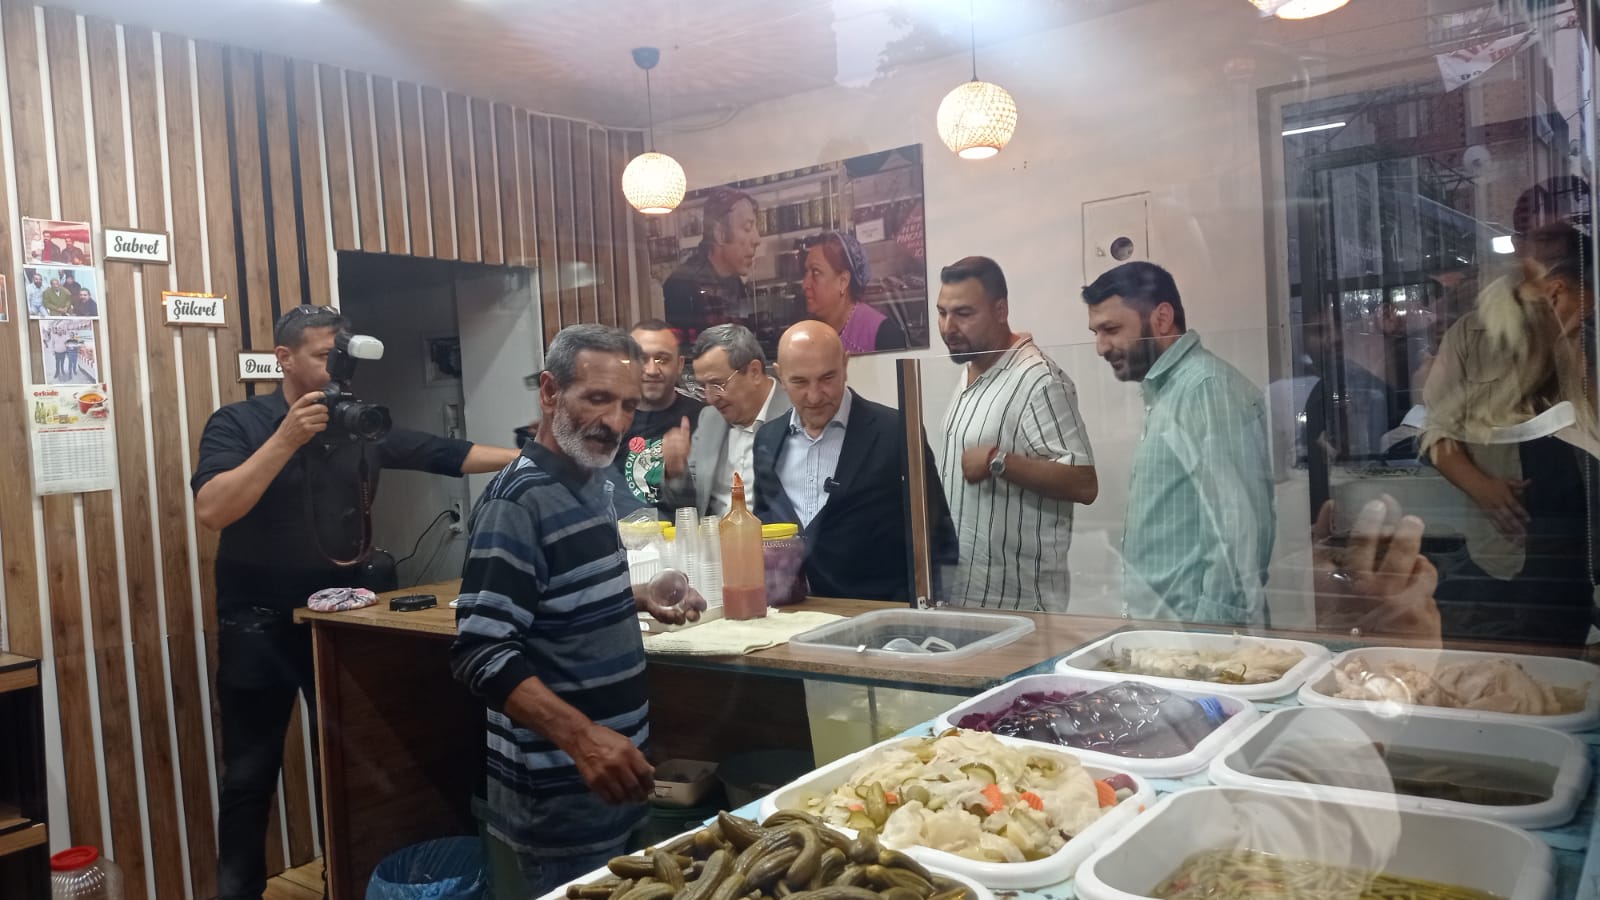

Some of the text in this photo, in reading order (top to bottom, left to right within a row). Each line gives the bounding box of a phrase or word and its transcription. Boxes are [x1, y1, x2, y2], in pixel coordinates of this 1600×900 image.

[114, 235, 159, 255] Sabret
[173, 299, 217, 319] Şükret
[245, 358, 272, 373] Dua
[624, 453, 641, 497] BOSTON
